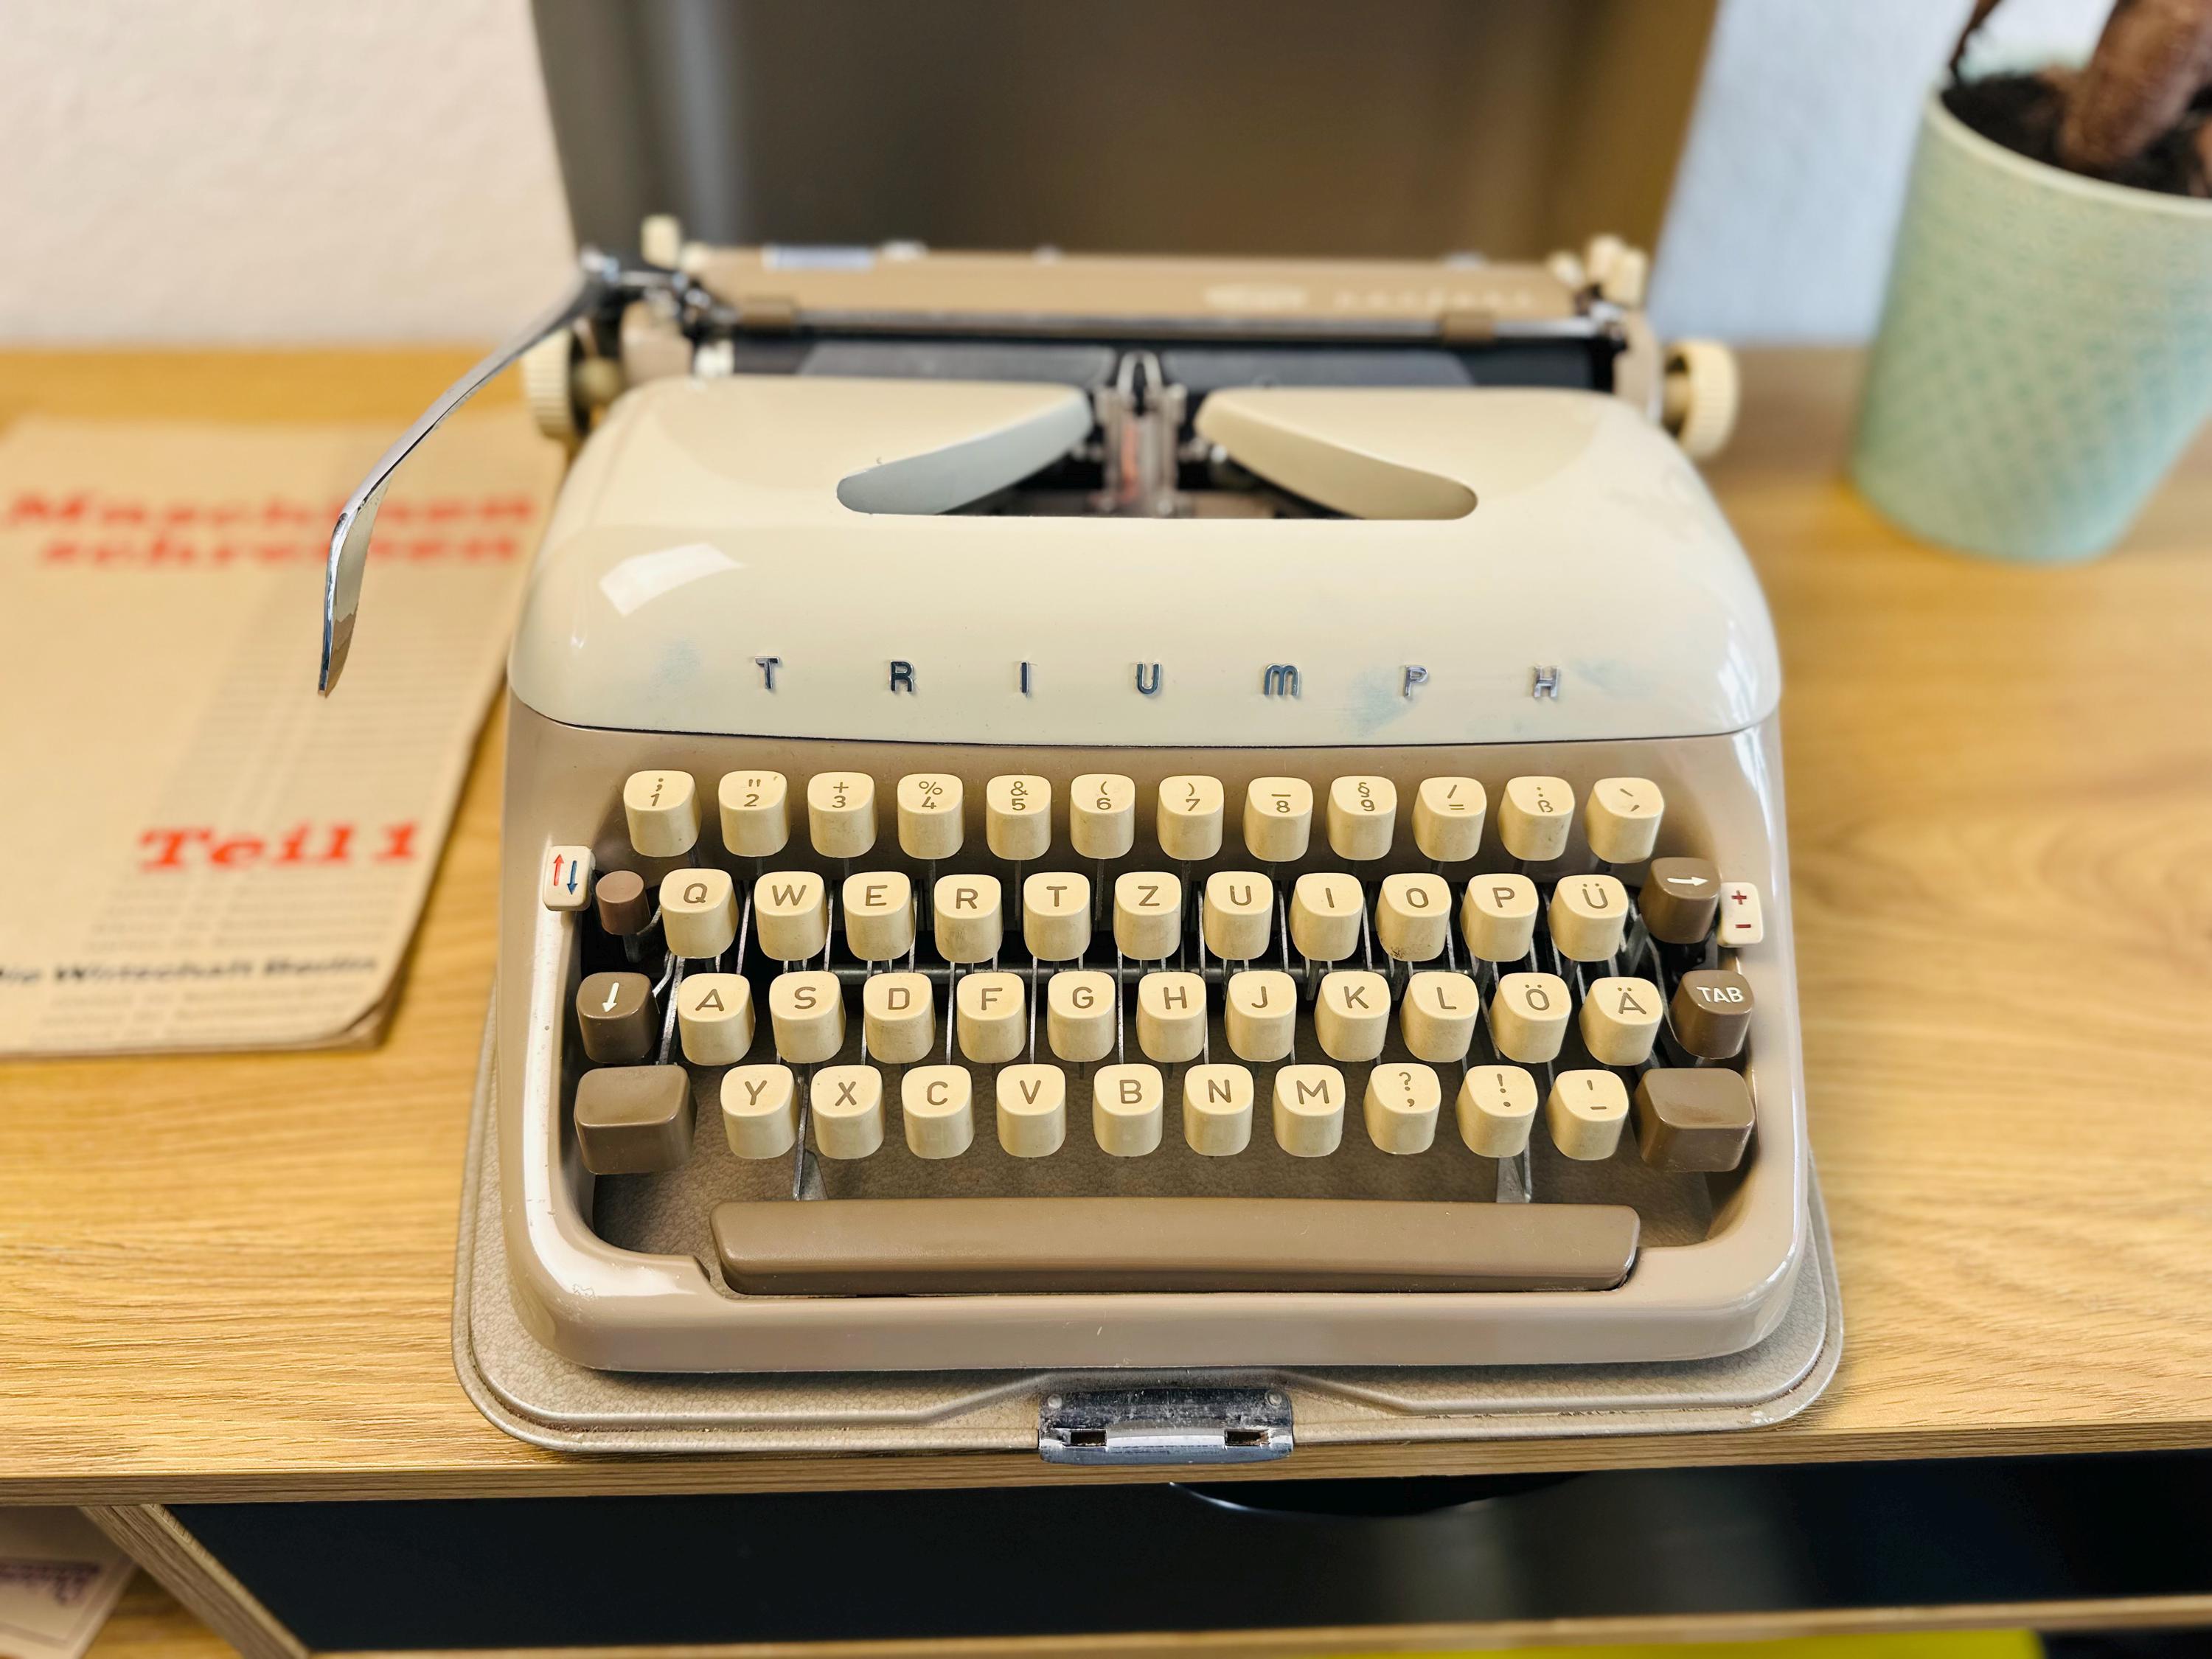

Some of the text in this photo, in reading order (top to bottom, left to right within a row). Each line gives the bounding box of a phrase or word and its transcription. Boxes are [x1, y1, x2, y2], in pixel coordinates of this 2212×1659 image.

[755, 655, 1562, 700] TRIUMPH
[833, 782, 849, 794] +
[919, 781, 943, 796] %
[1010, 781, 1029, 796] &
[1100, 781, 1107, 796] (
[1188, 782, 1195, 797] )
[650, 793, 661, 807] 1
[744, 793, 759, 807] 2
[832, 796, 846, 808] 3
[921, 796, 937, 810] 4
[1012, 798, 1026, 811] 5
[1096, 797, 1112, 810] 6
[1185, 799, 1200, 812] 7
[1276, 800, 1291, 813] 8
[1360, 799, 1375, 812] 9
[139, 821, 417, 872] Teil 1
[683, 883, 708, 904] Q
[771, 884, 807, 907] W
[865, 884, 888, 907] E
[956, 888, 978, 910] R
[1046, 886, 1068, 908] T
[1137, 886, 1161, 907] Z
[1229, 885, 1252, 906] U
[1325, 887, 1332, 908] I
[1405, 887, 1429, 908] O
[1492, 887, 1515, 908] P
[1582, 882, 1609, 910] Ü
[695, 988, 725, 1012] A
[794, 986, 817, 1009] S
[888, 987, 911, 1010] D
[981, 987, 1003, 1011] F
[1072, 986, 1094, 1009] G
[1163, 986, 1188, 1010] H
[1251, 986, 1268, 1009] J
[1343, 986, 1369, 1009] K
[1436, 987, 1457, 1010] L
[1525, 984, 1550, 1011] Ö
[1617, 987, 1647, 1015] Ä
[1696, 987, 1744, 1003] TAB
[1019, 1079, 1042, 1105] V
[1119, 1079, 1143, 1105] B
[1208, 1079, 1232, 1104] N
[1295, 1079, 1330, 1105] M
[1399, 1071, 1411, 1091] ?
[1497, 1073, 1506, 1093] !
[744, 1079, 768, 1106] Y
[835, 1081, 858, 1107] X
[927, 1081, 948, 1106] C
